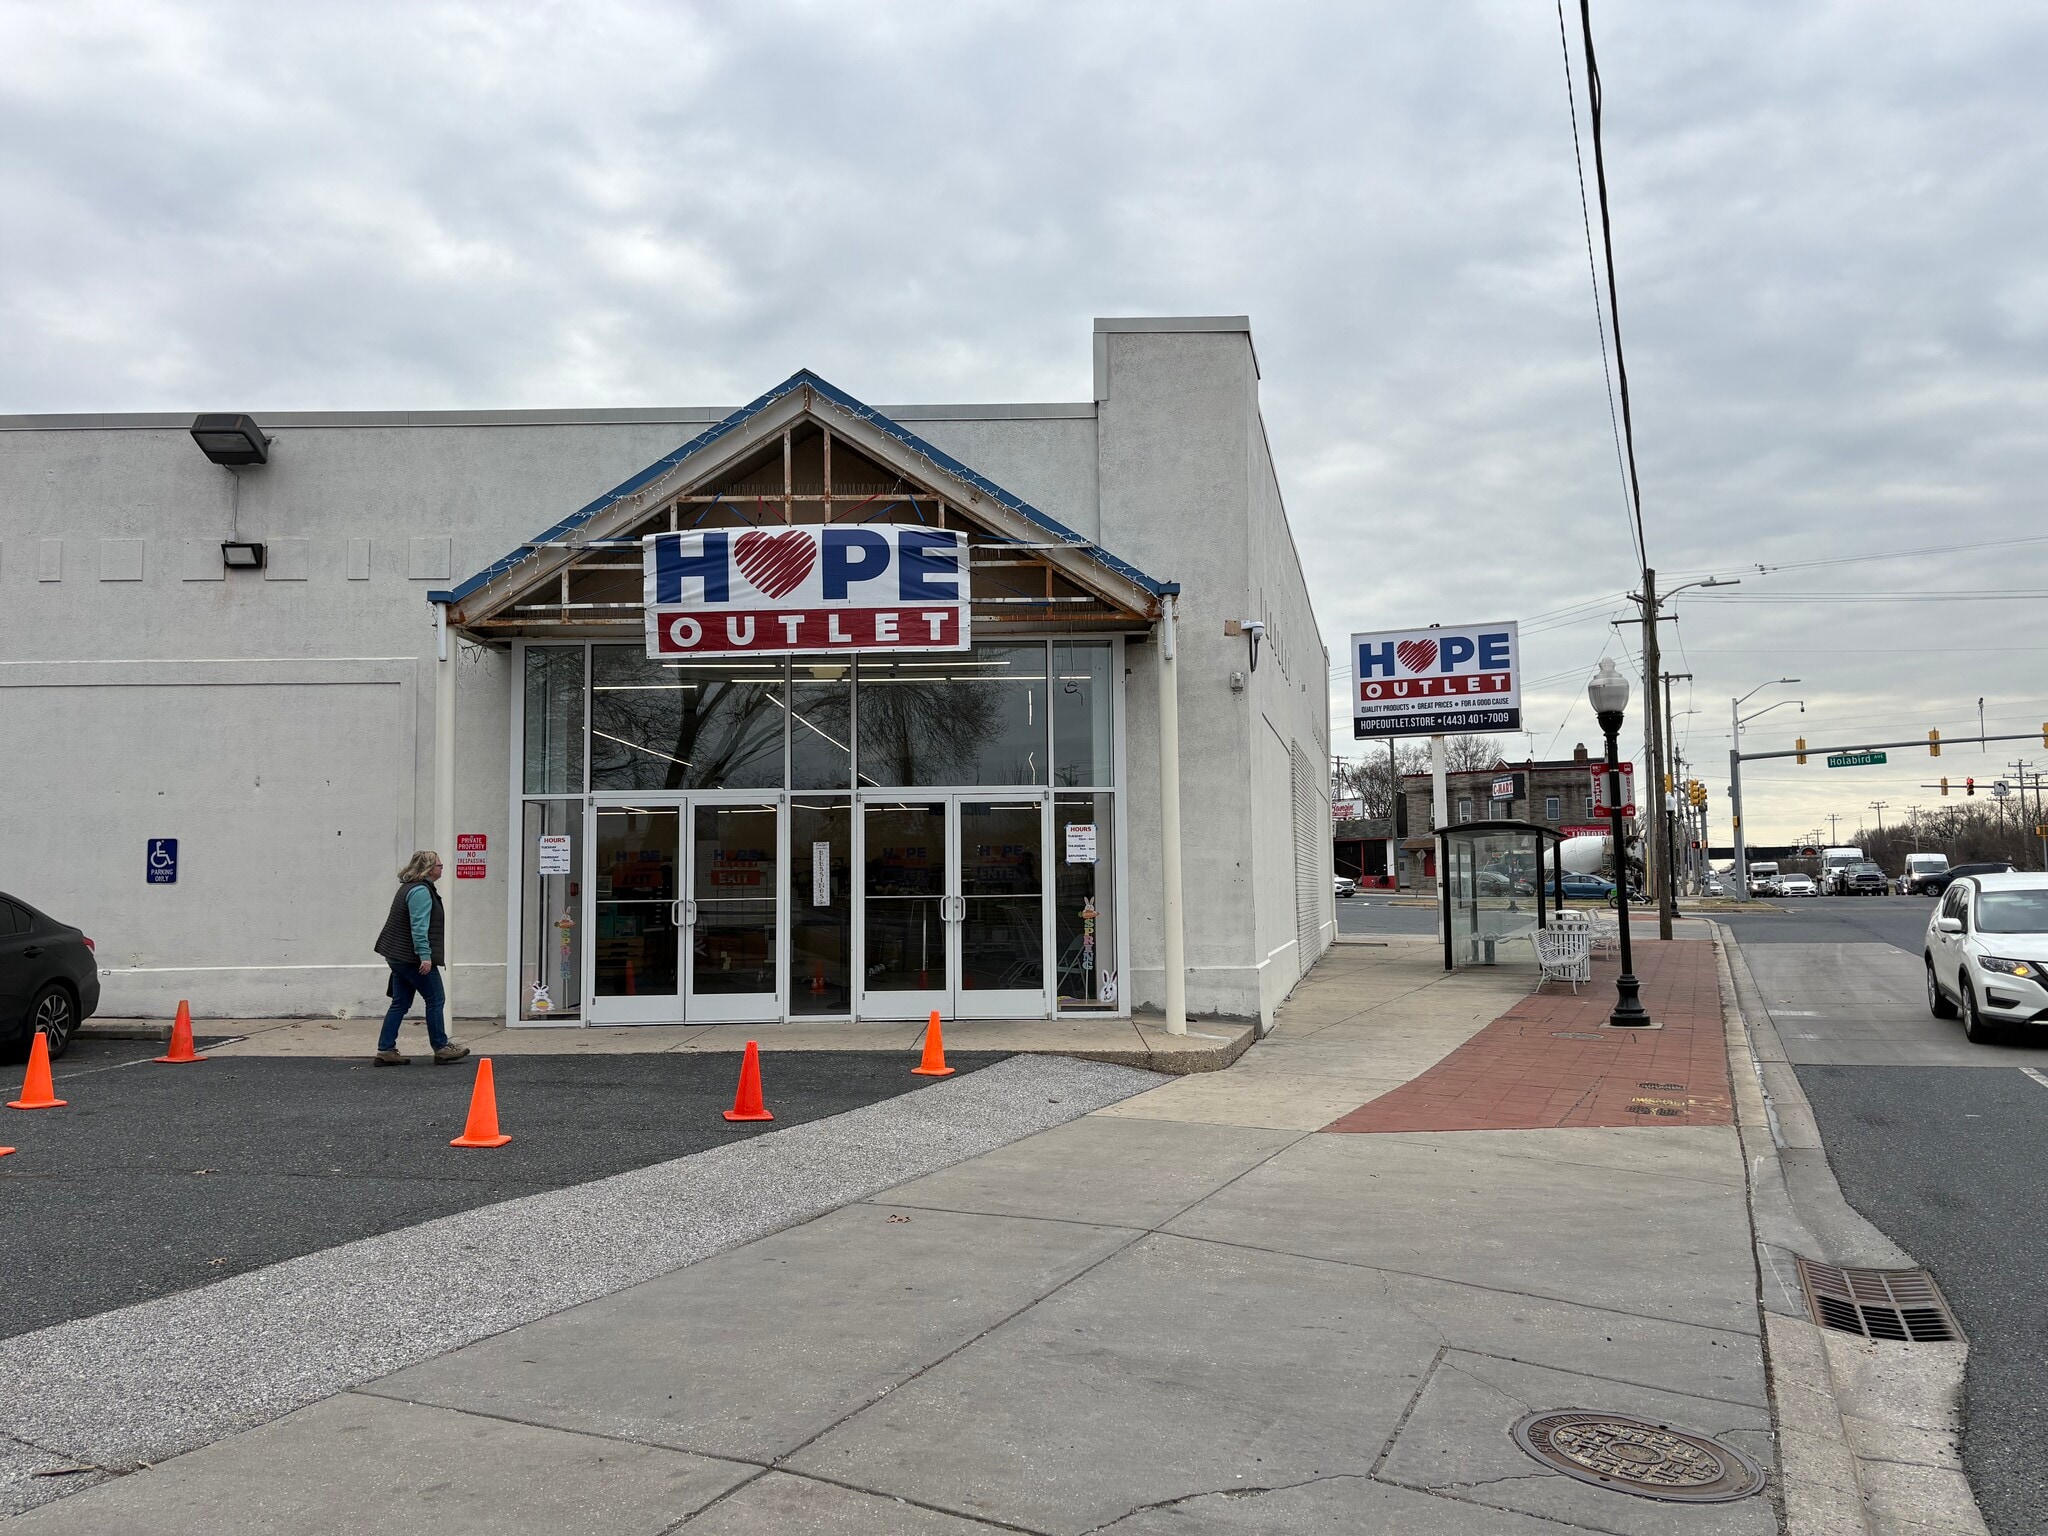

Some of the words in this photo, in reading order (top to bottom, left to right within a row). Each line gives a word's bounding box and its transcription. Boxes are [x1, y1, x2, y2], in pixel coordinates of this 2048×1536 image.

[669, 612, 949, 648] OUTLET
[1366, 676, 1505, 698] OUTLET
[1361, 705, 1383, 714] QUALITY
[1383, 704, 1410, 712] PRODUCTS
[1417, 702, 1434, 710] GREAT
[1434, 701, 1453, 709] PRICES
[1461, 699, 1471, 707] FOR
[1472, 699, 1476, 707] A
[1477, 698, 1492, 706] GOOD
[1492, 697, 1509, 705] CAUSE
[1361, 716, 1435, 730] HOPEOUTLET.STORE
[1443, 714, 1466, 726] (443)
[1468, 712, 1509, 724] 401-7009
[1830, 755, 1871, 766] Holabird
[719, 873, 749, 884] EXIT
[1082, 918, 1094, 970] SPRING
